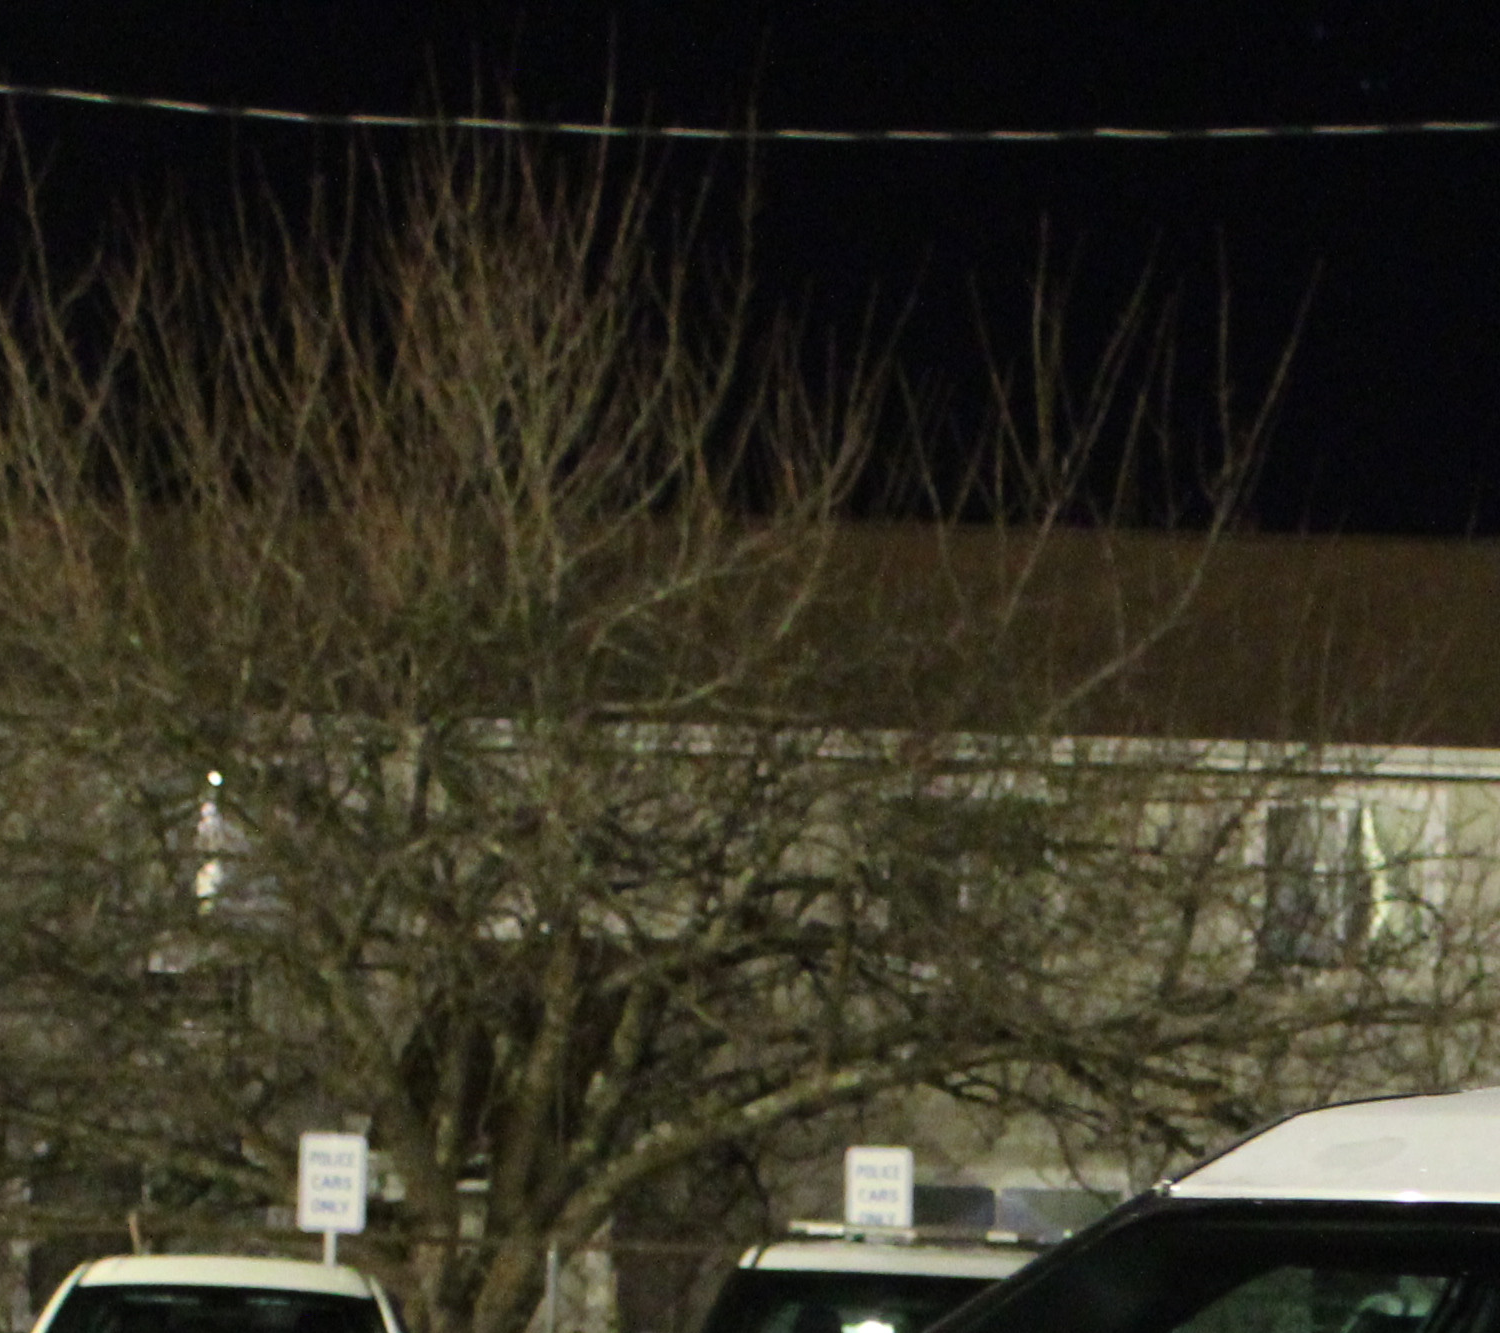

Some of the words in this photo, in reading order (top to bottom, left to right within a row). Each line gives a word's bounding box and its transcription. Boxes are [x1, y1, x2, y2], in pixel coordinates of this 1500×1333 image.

[310, 1151, 354, 1167] POLICE
[856, 1164, 900, 1180] POLICE
[311, 1174, 352, 1191] CARS
[857, 1188, 899, 1203] CARS
[311, 1198, 350, 1214] ONLY
